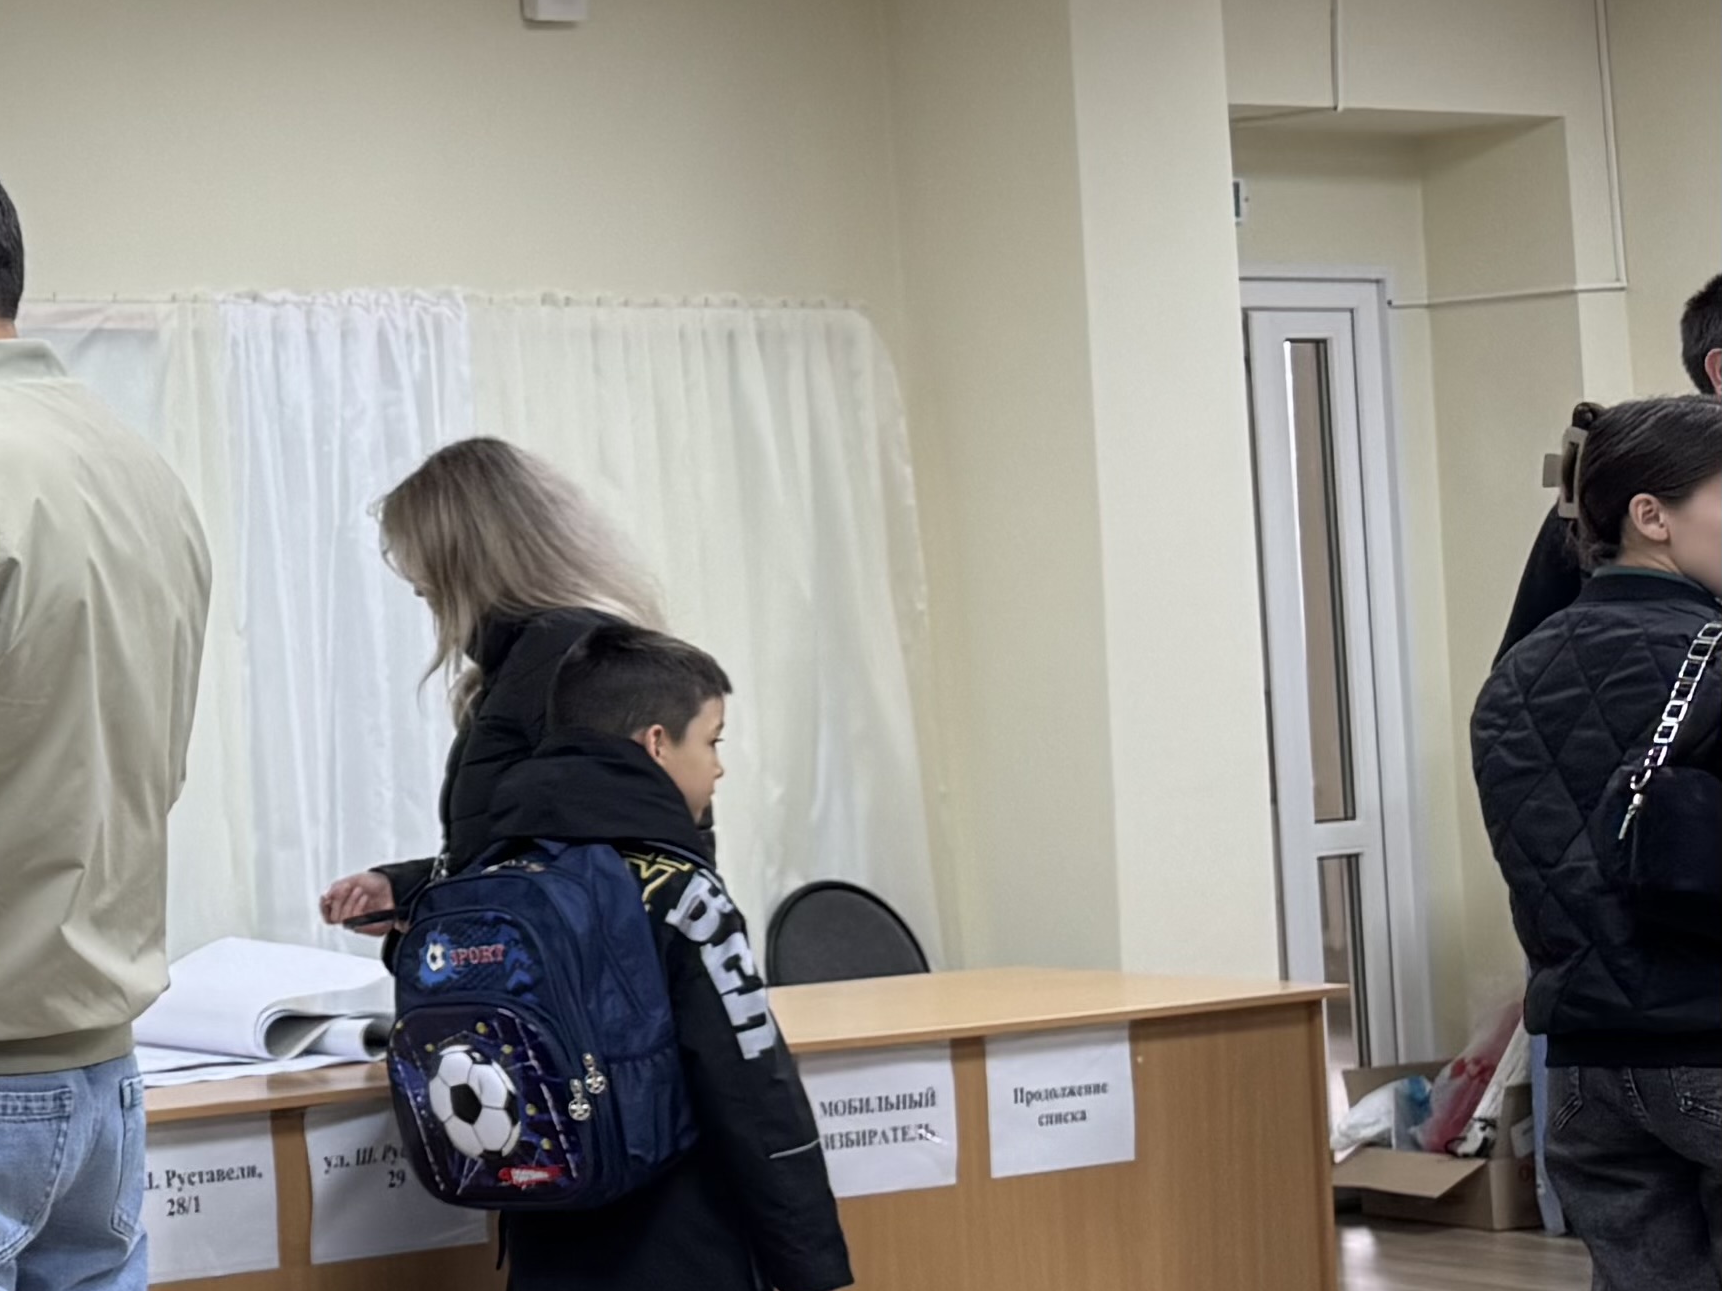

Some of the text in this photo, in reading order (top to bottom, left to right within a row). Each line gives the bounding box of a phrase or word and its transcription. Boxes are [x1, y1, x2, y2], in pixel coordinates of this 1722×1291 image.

[818, 1086, 938, 1119] МОБИЛЬНЫЙ
[1013, 1081, 1109, 1108] Продолжение
[1037, 1109, 1088, 1128] списка
[822, 1124, 938, 1152] ИЗБИРАТЕЛЬ
[323, 1154, 350, 1174] ул.
[355, 1148, 378, 1167] Ш.
[165, 1164, 263, 1192] Руставели,
[387, 1169, 406, 1189] 29
[165, 1195, 201, 1217] 28/1
